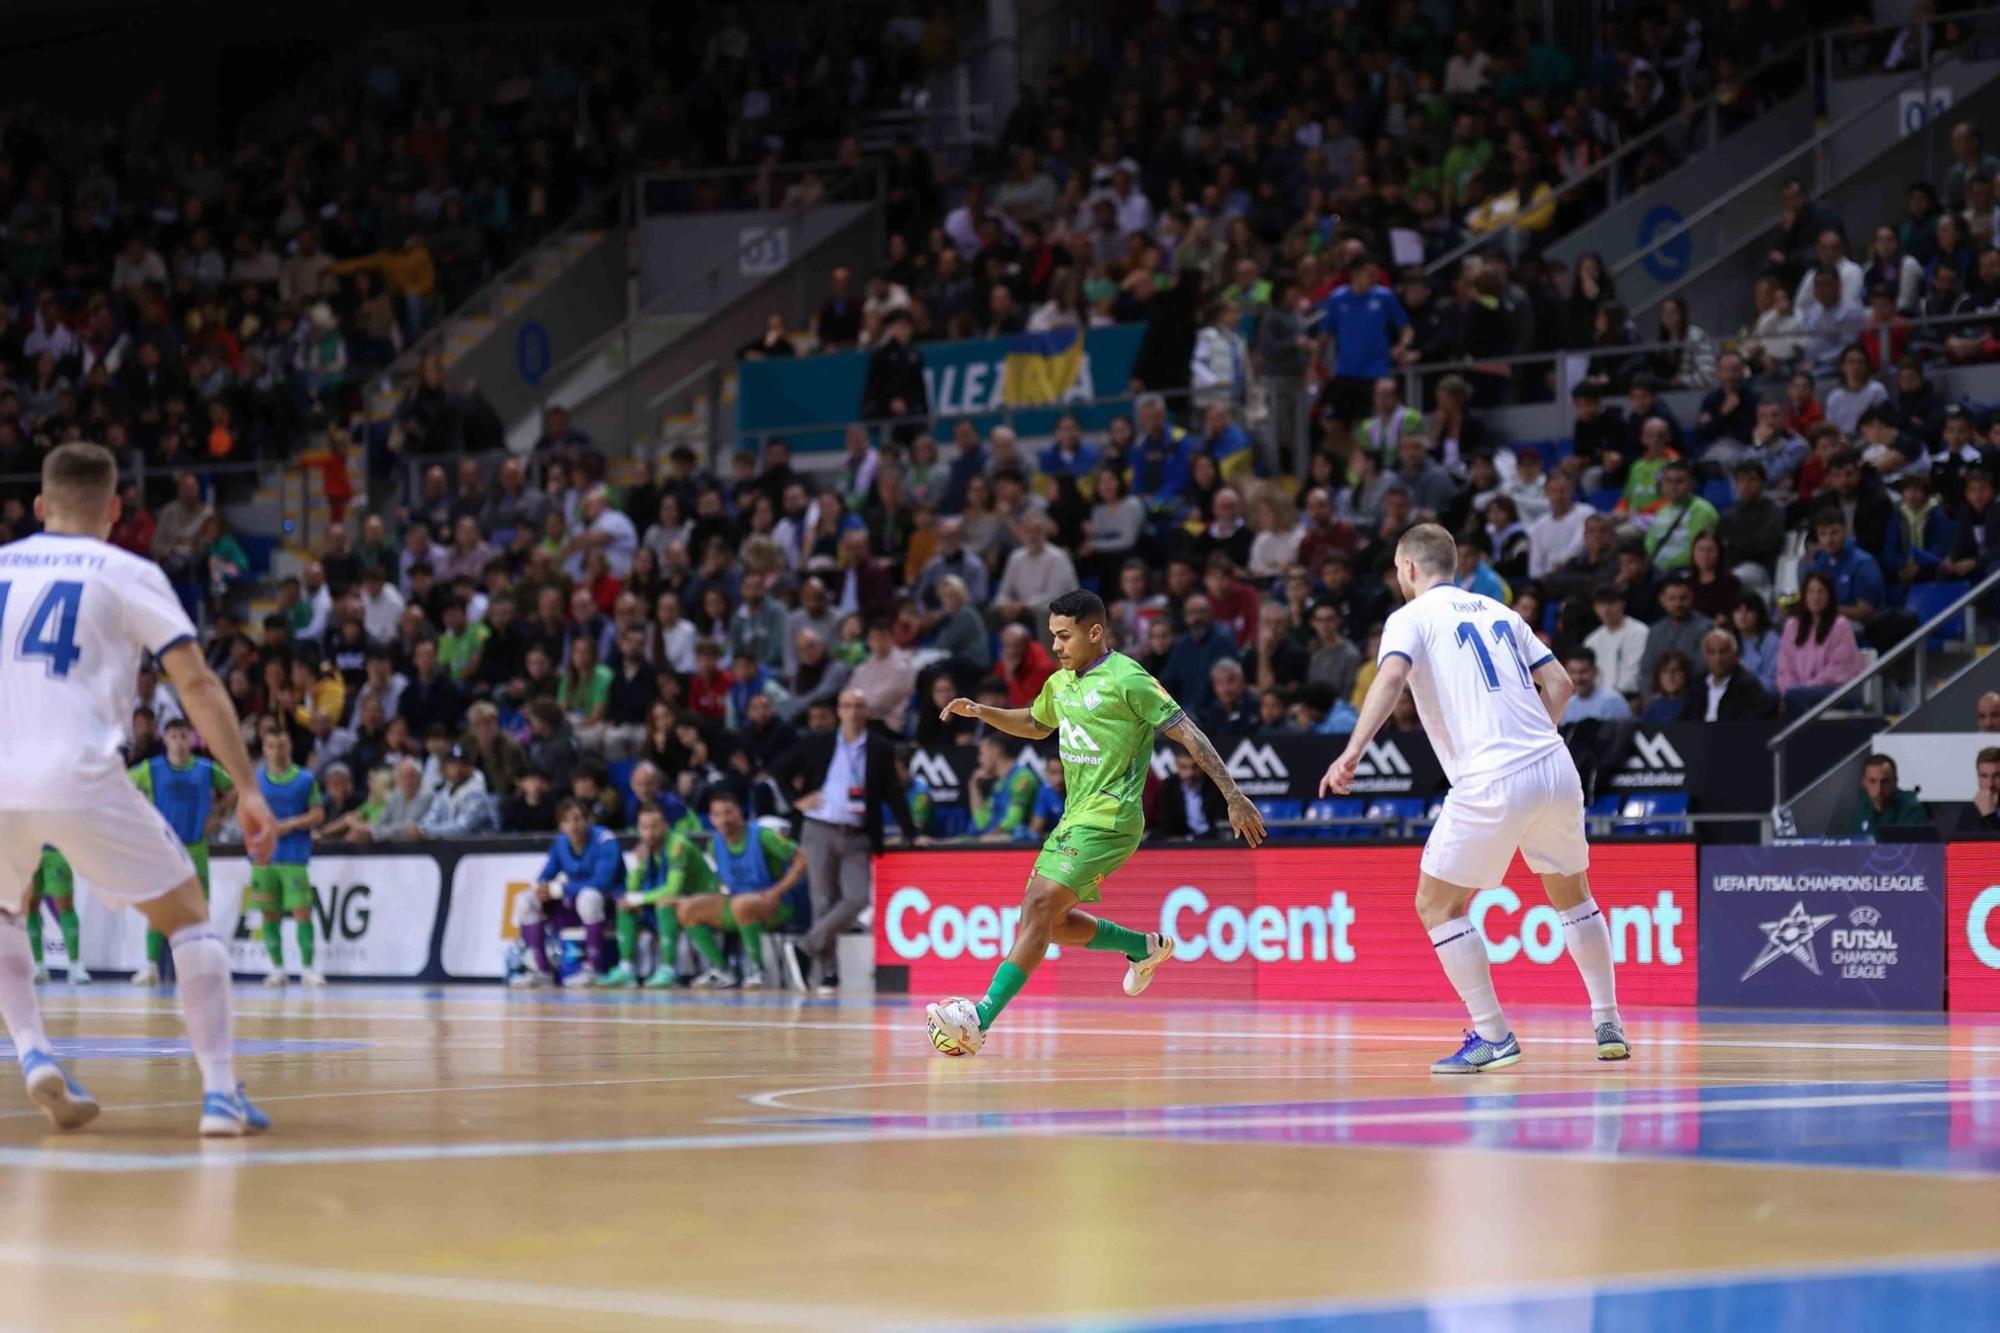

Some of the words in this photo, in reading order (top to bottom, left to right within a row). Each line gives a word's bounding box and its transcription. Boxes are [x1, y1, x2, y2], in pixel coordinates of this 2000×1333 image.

[1454, 620, 1532, 693] 11
[1713, 875, 1747, 892] UEFA
[1747, 875, 1797, 892] FUTSAL
[1798, 875, 1873, 892] CHAMPIONS
[1875, 875, 1925, 892] LEAGUE
[1160, 886, 1356, 963] Coent
[1467, 886, 1684, 966] Cont
[1831, 929, 1899, 949] FUTSAL
[1831, 950, 1899, 965] CHAMPIONS
[1842, 965, 1887, 979] LEAGUE
